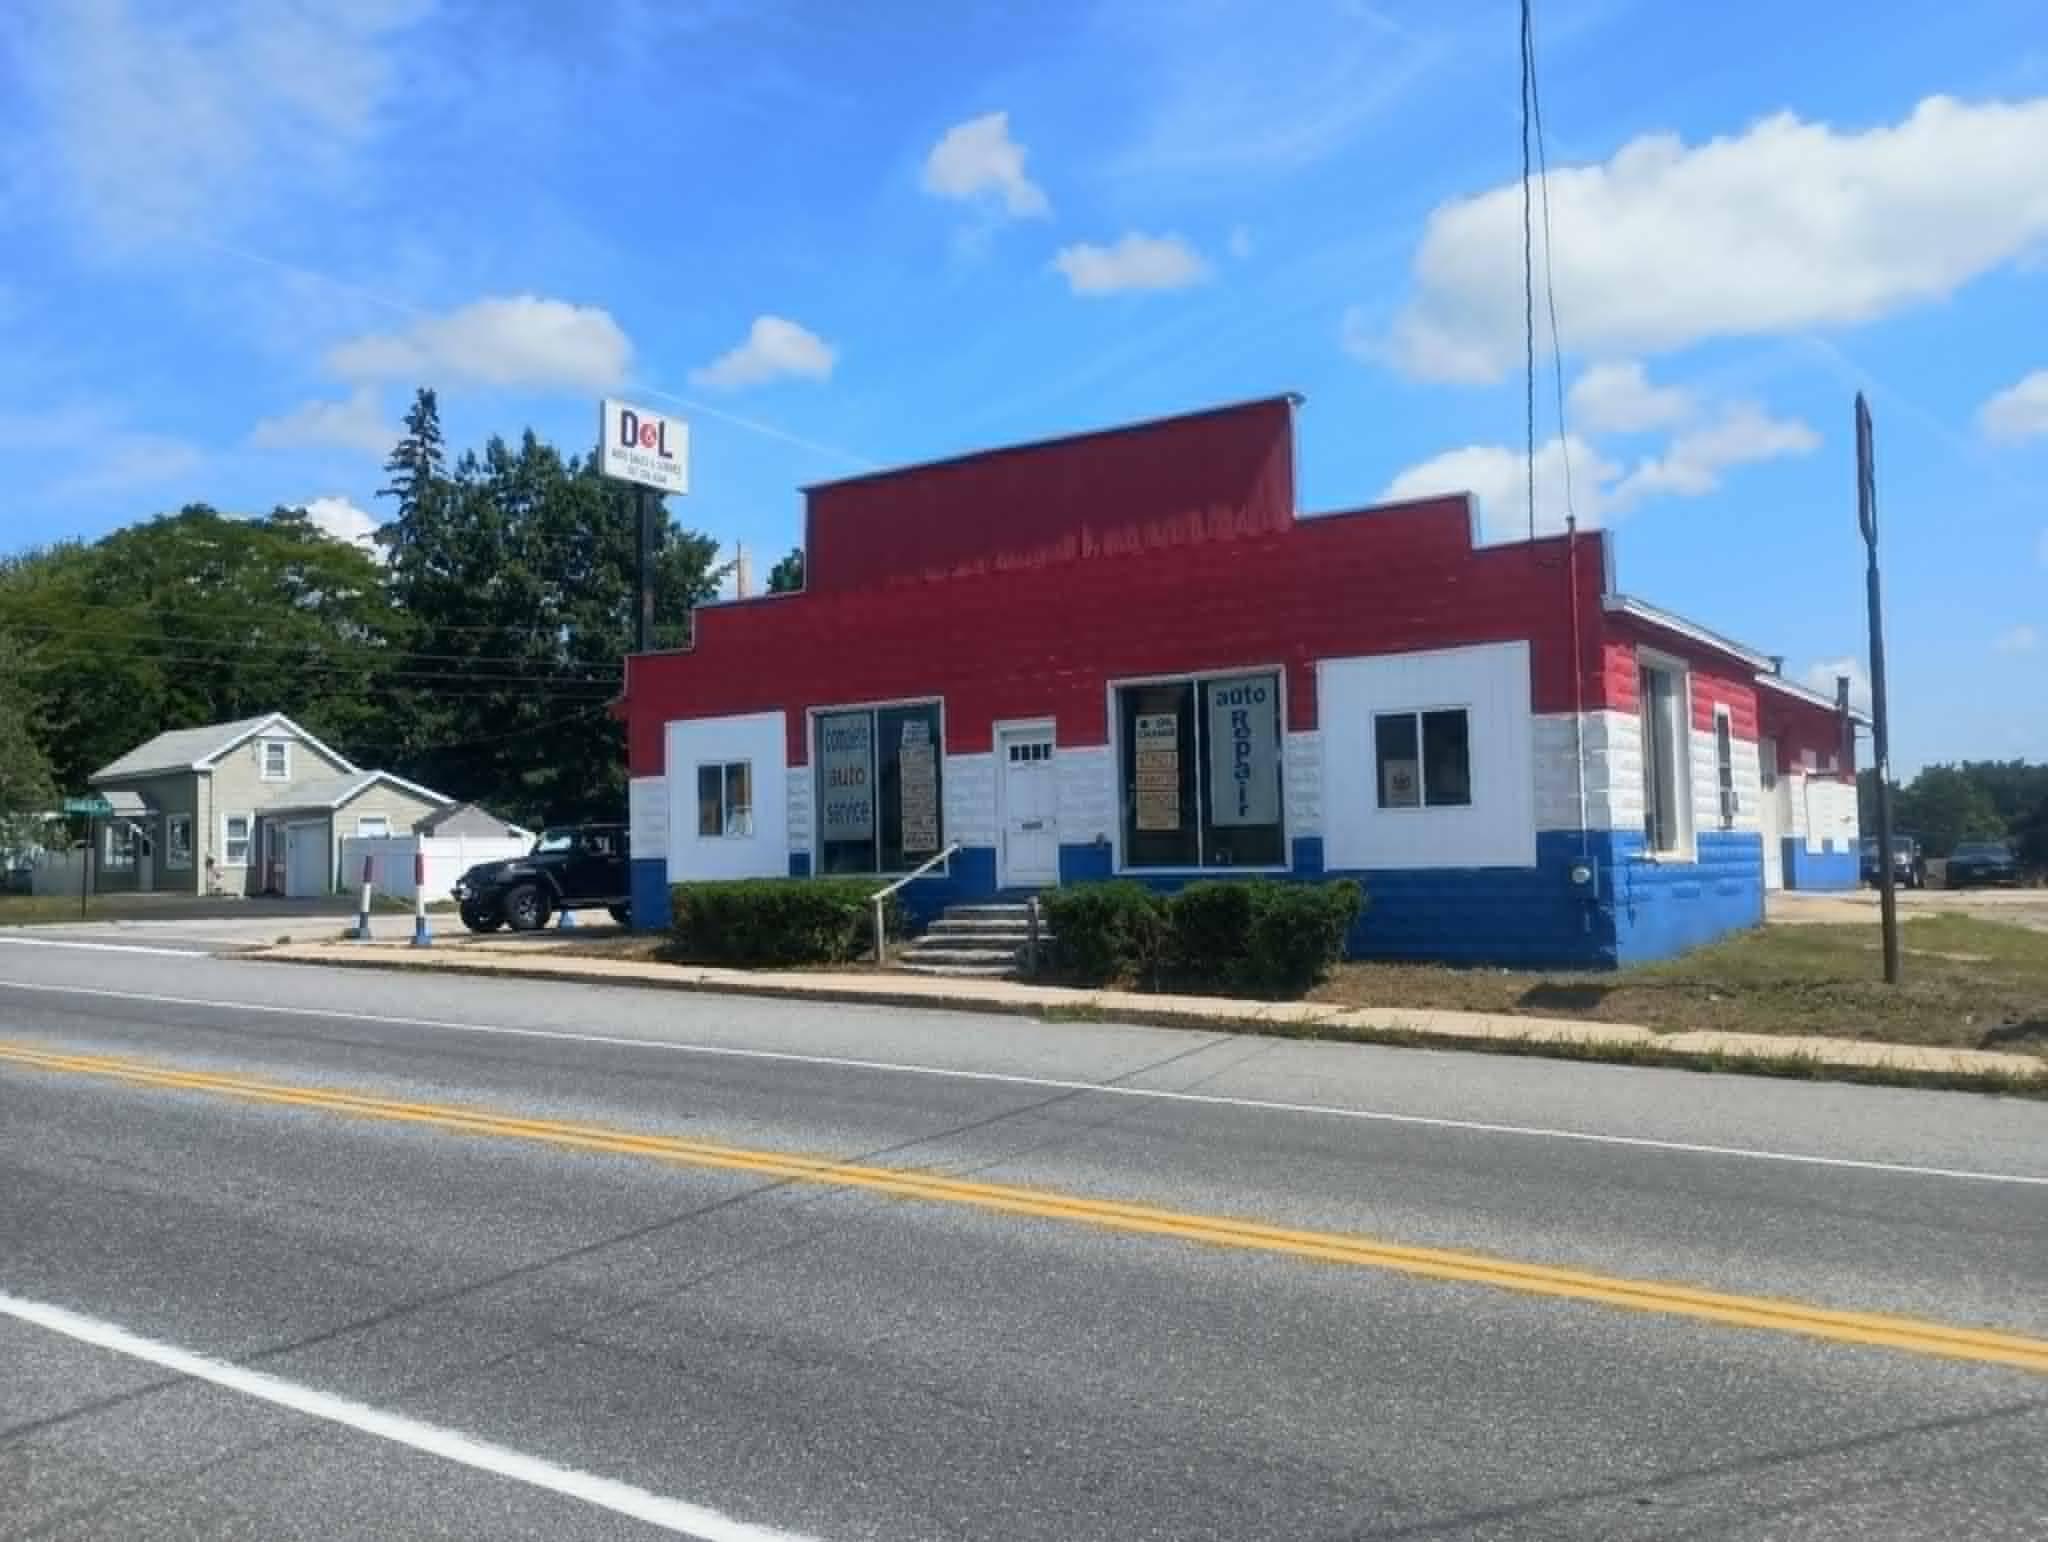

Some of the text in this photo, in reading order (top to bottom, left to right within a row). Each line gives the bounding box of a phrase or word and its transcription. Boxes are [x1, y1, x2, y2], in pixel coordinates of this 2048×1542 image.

[1216, 685, 1266, 706] auto
[1232, 710, 1250, 816] Repair
[830, 764, 865, 786] auto
